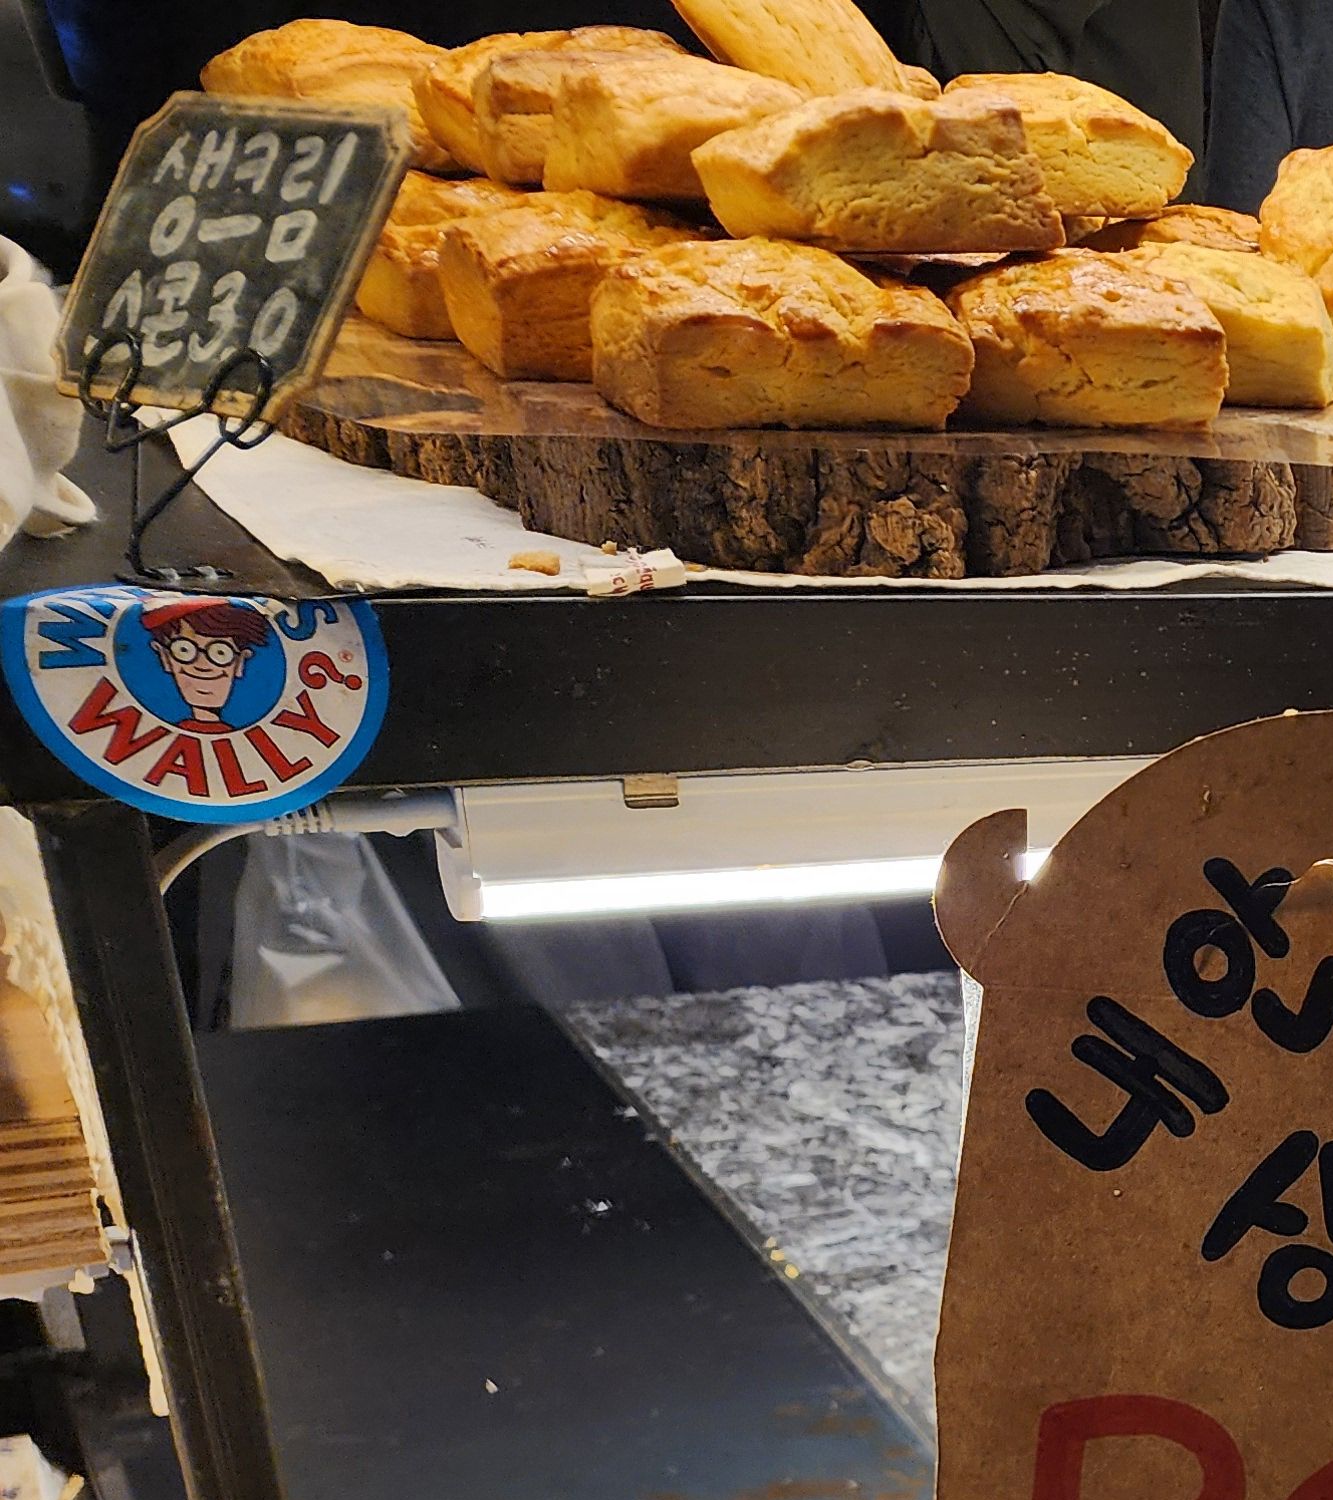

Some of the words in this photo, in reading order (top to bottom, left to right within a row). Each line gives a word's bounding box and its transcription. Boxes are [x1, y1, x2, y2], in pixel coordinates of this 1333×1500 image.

[152, 127, 358, 263] 생크림
[84, 261, 200, 367] 스콘
[187, 270, 299, 361] 3.0
[68, 651, 363, 798] WALLY?
